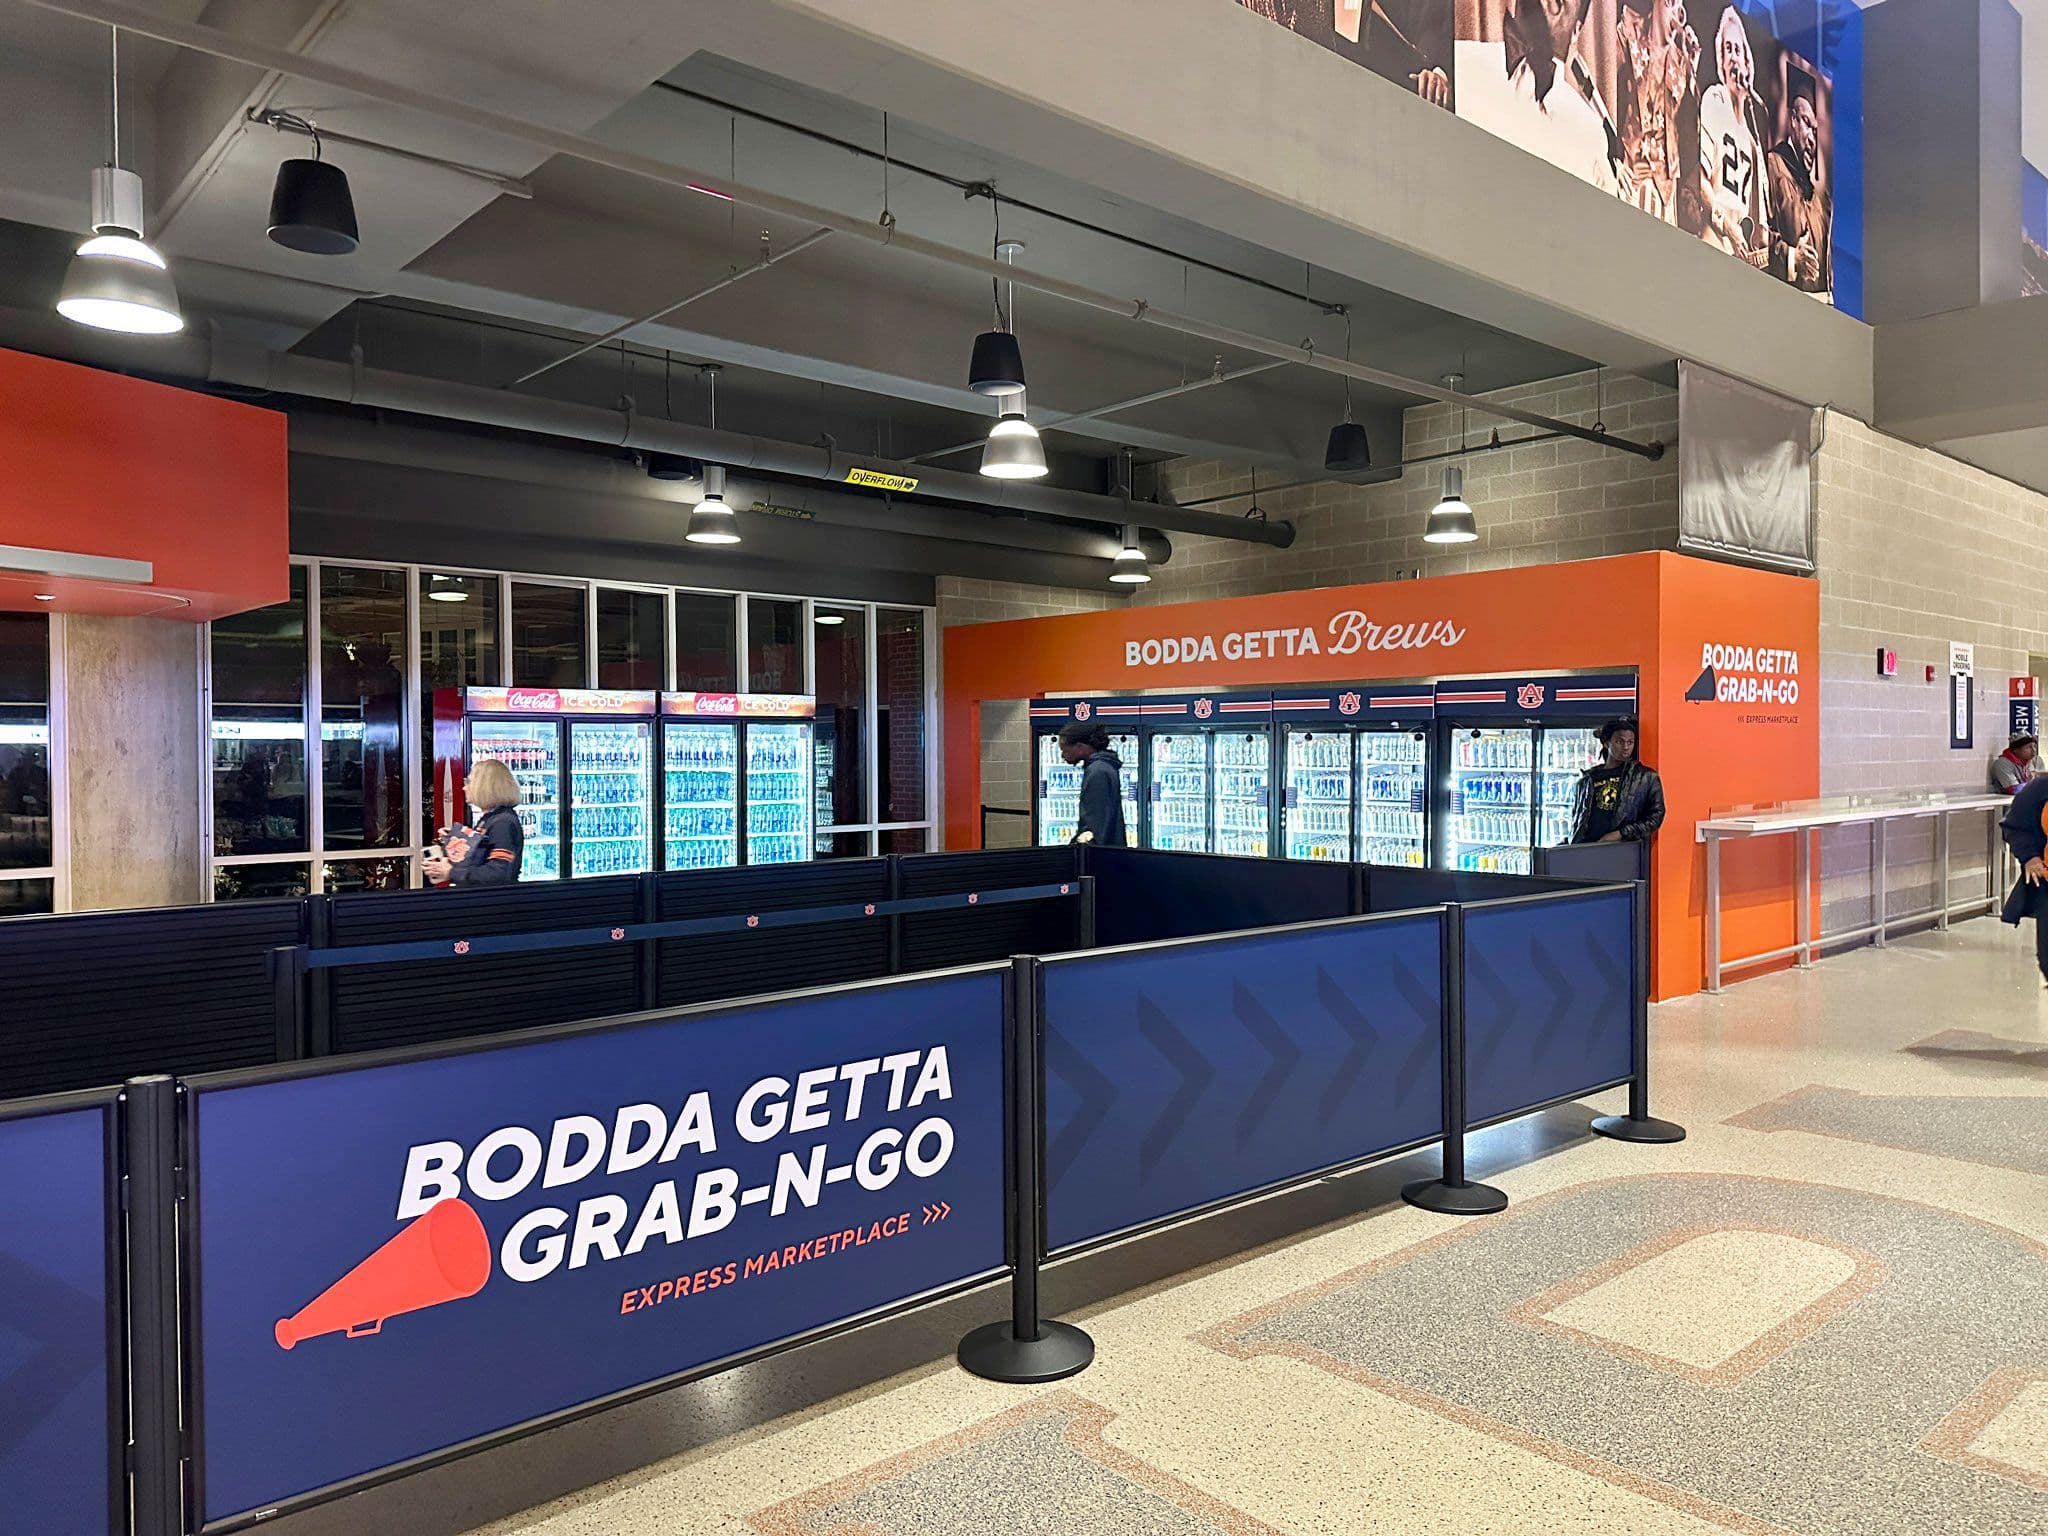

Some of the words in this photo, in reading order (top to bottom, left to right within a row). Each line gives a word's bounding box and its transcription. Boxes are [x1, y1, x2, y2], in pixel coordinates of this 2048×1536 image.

[1722, 133, 1752, 205] 27
[851, 472, 904, 489] OVERFLOW
[1126, 635, 1217, 666] BODDA
[1222, 627, 1320, 661] GETTA
[1327, 610, 1466, 655] Brews
[1702, 643, 1754, 672] BODDA
[1756, 648, 1799, 675] GETTA
[563, 696, 585, 708] ICE
[588, 696, 625, 709] COLD
[741, 700, 759, 711] ICE
[761, 700, 790, 711] COLD
[1717, 676, 1799, 705] GRAB-N-GO
[396, 1091, 718, 1221] BODDA
[735, 1045, 953, 1143] GETTA
[500, 1117, 955, 1283] GRAB-N-GO
[620, 1262, 738, 1315] EXPRESS
[744, 1212, 912, 1280] MARKETPLACE
